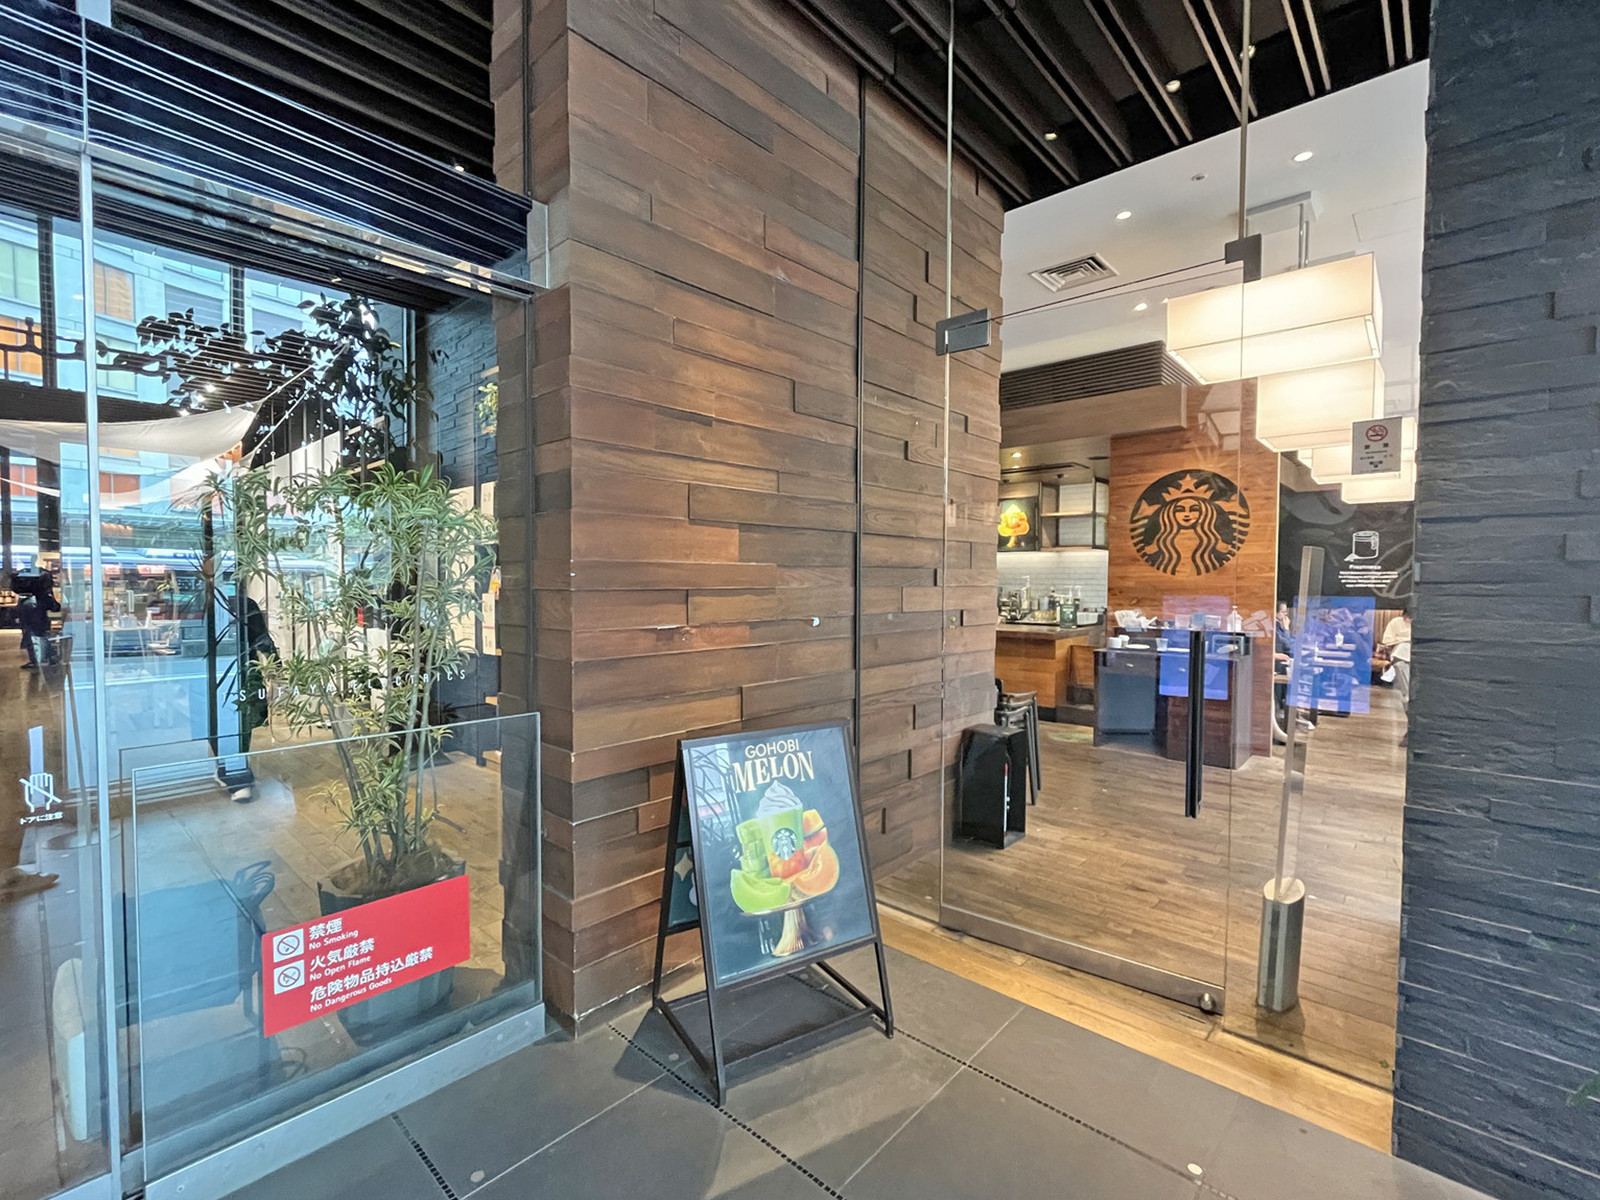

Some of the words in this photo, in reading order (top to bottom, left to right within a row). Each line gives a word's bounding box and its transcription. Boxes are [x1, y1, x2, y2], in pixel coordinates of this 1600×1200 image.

[221, 681, 333, 701] SUTAYA
[352, 669, 466, 692] ELCTRICS
[744, 738, 800, 759] GOHOBI
[732, 750, 815, 794] MELON
[308, 941, 322, 951] No
[323, 930, 359, 947] Smoking
[309, 917, 343, 940] 禁煙
[309, 972, 323, 982] No
[324, 964, 346, 977] Open
[347, 955, 372, 969] Flame
[310, 937, 375, 972] 火気厳禁
[310, 946, 434, 1004] 危険物品持込厳禁
[309, 1003, 323, 1013] No
[324, 987, 367, 1008] Dangerous
[368, 976, 393, 991] Goods
